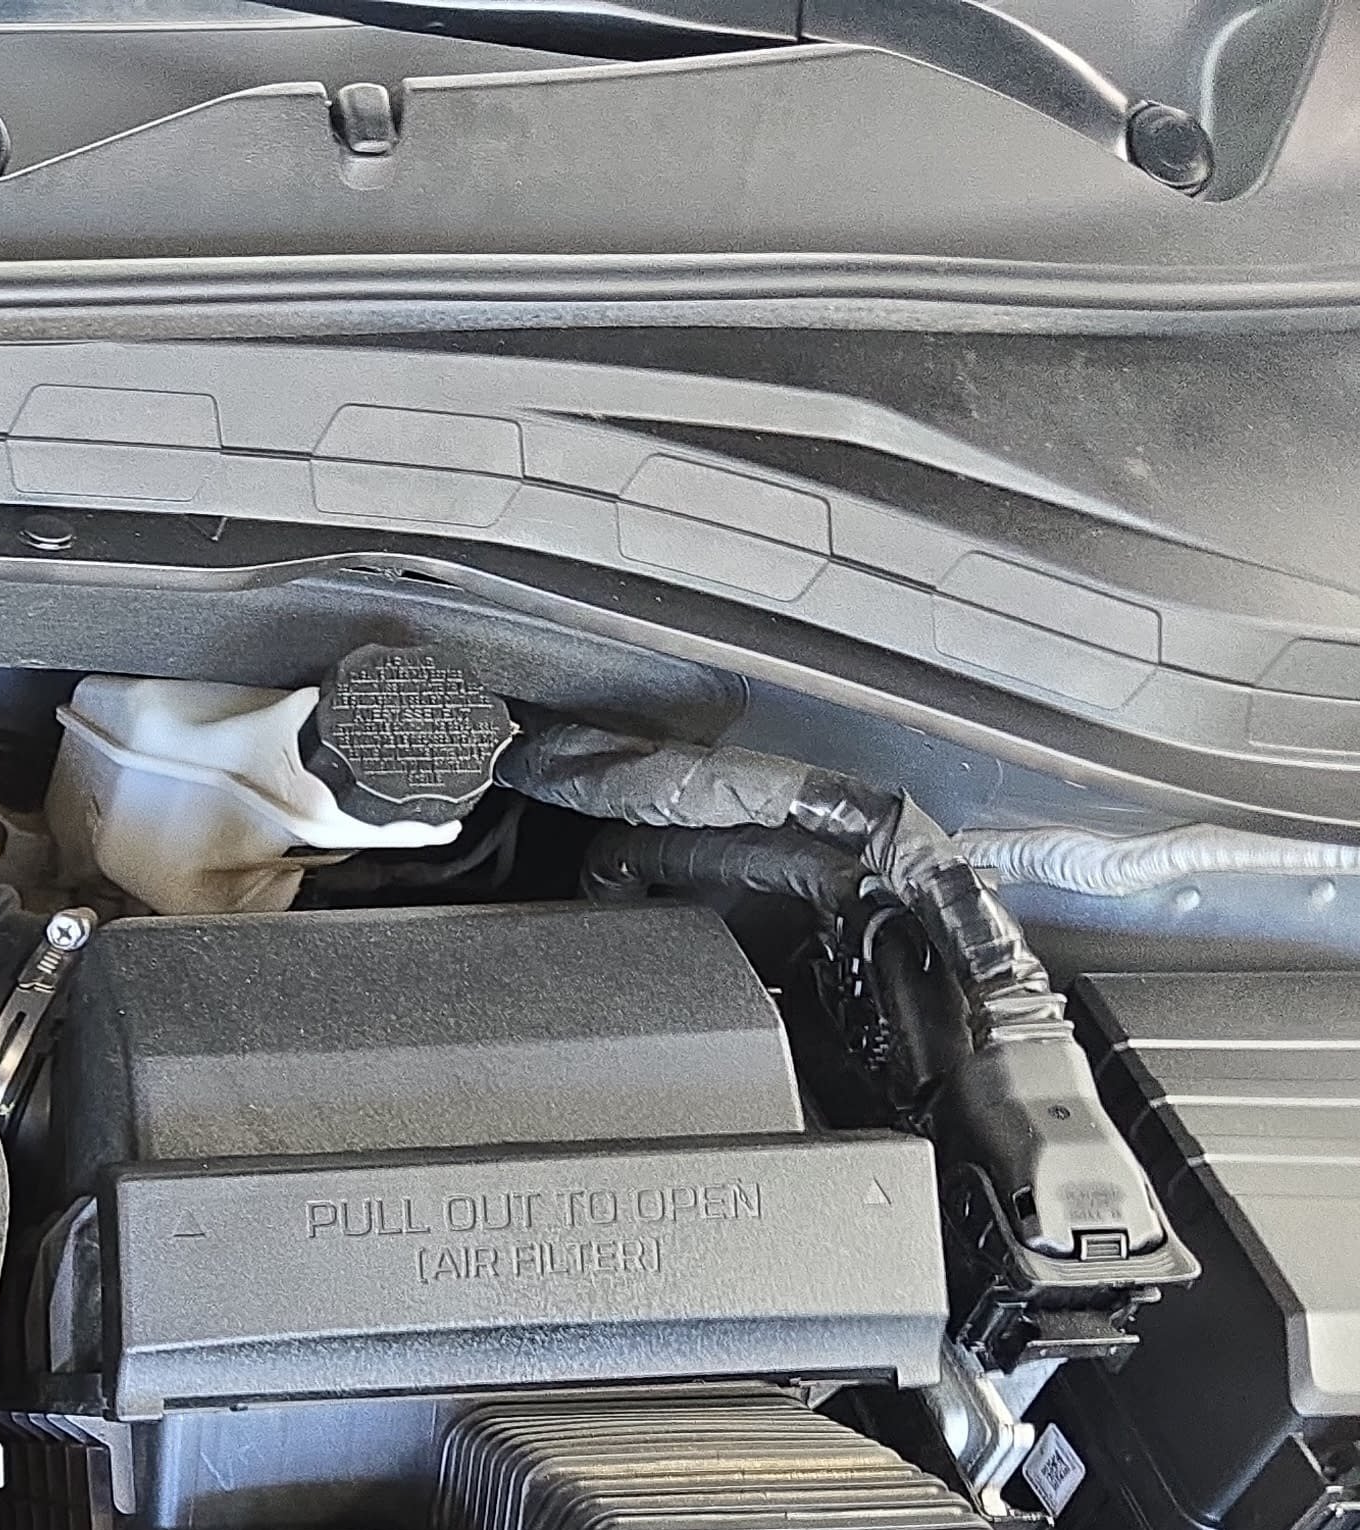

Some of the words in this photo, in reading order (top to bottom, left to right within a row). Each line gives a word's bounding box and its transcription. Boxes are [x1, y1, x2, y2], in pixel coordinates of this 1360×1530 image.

[305, 1194, 431, 1239] PULL
[443, 1190, 540, 1232] OUT
[556, 1189, 618, 1227] TO
[634, 1181, 762, 1222] OPEN
